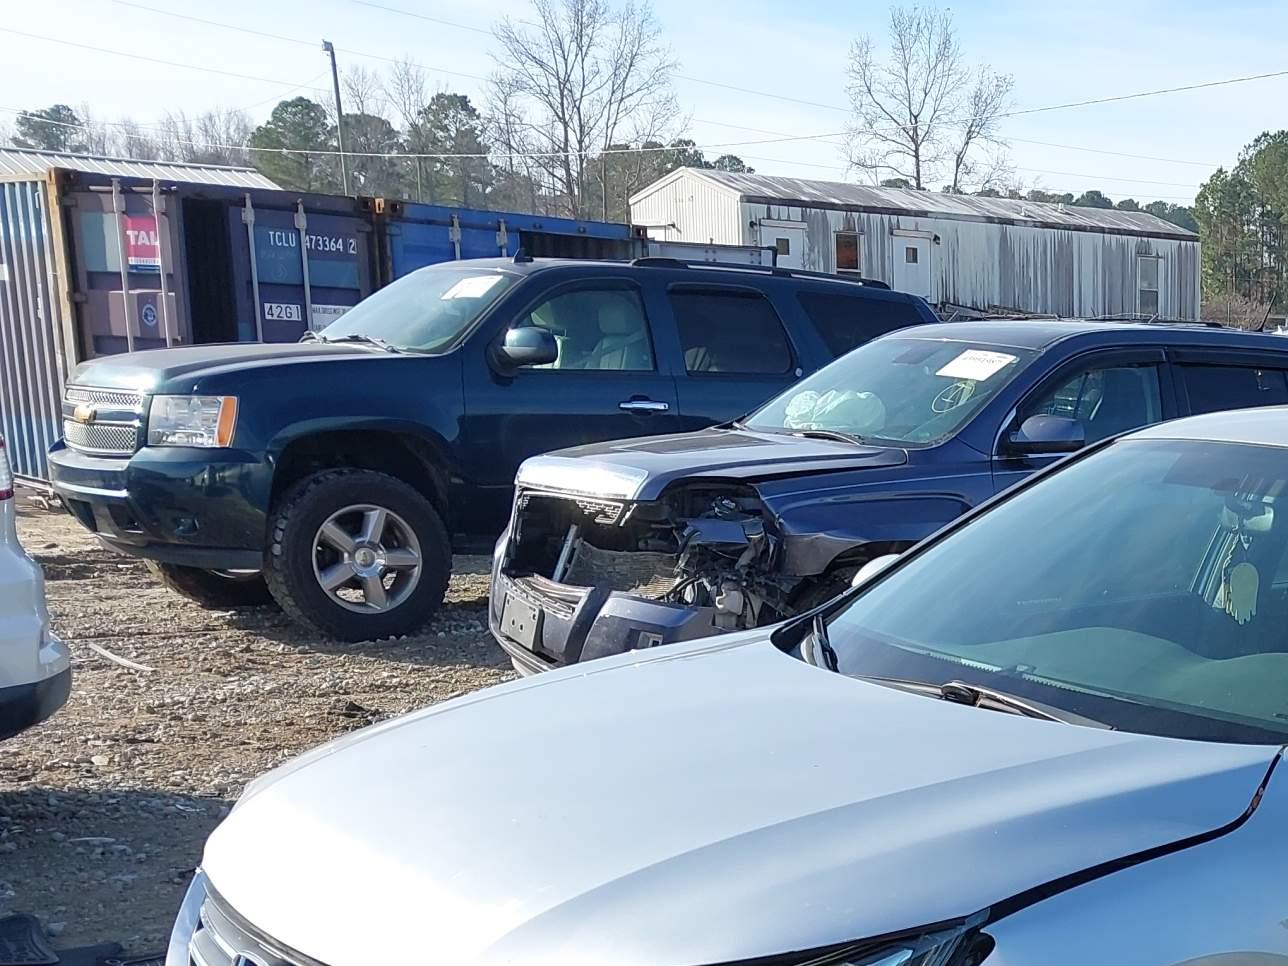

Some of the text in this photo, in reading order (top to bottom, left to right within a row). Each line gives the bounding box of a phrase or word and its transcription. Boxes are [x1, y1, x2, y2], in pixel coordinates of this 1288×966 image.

[126, 230, 159, 246] TAL
[268, 231, 296, 247] TCLU
[348, 238, 358, 254] 2
[266, 304, 300, 320] 42G1
